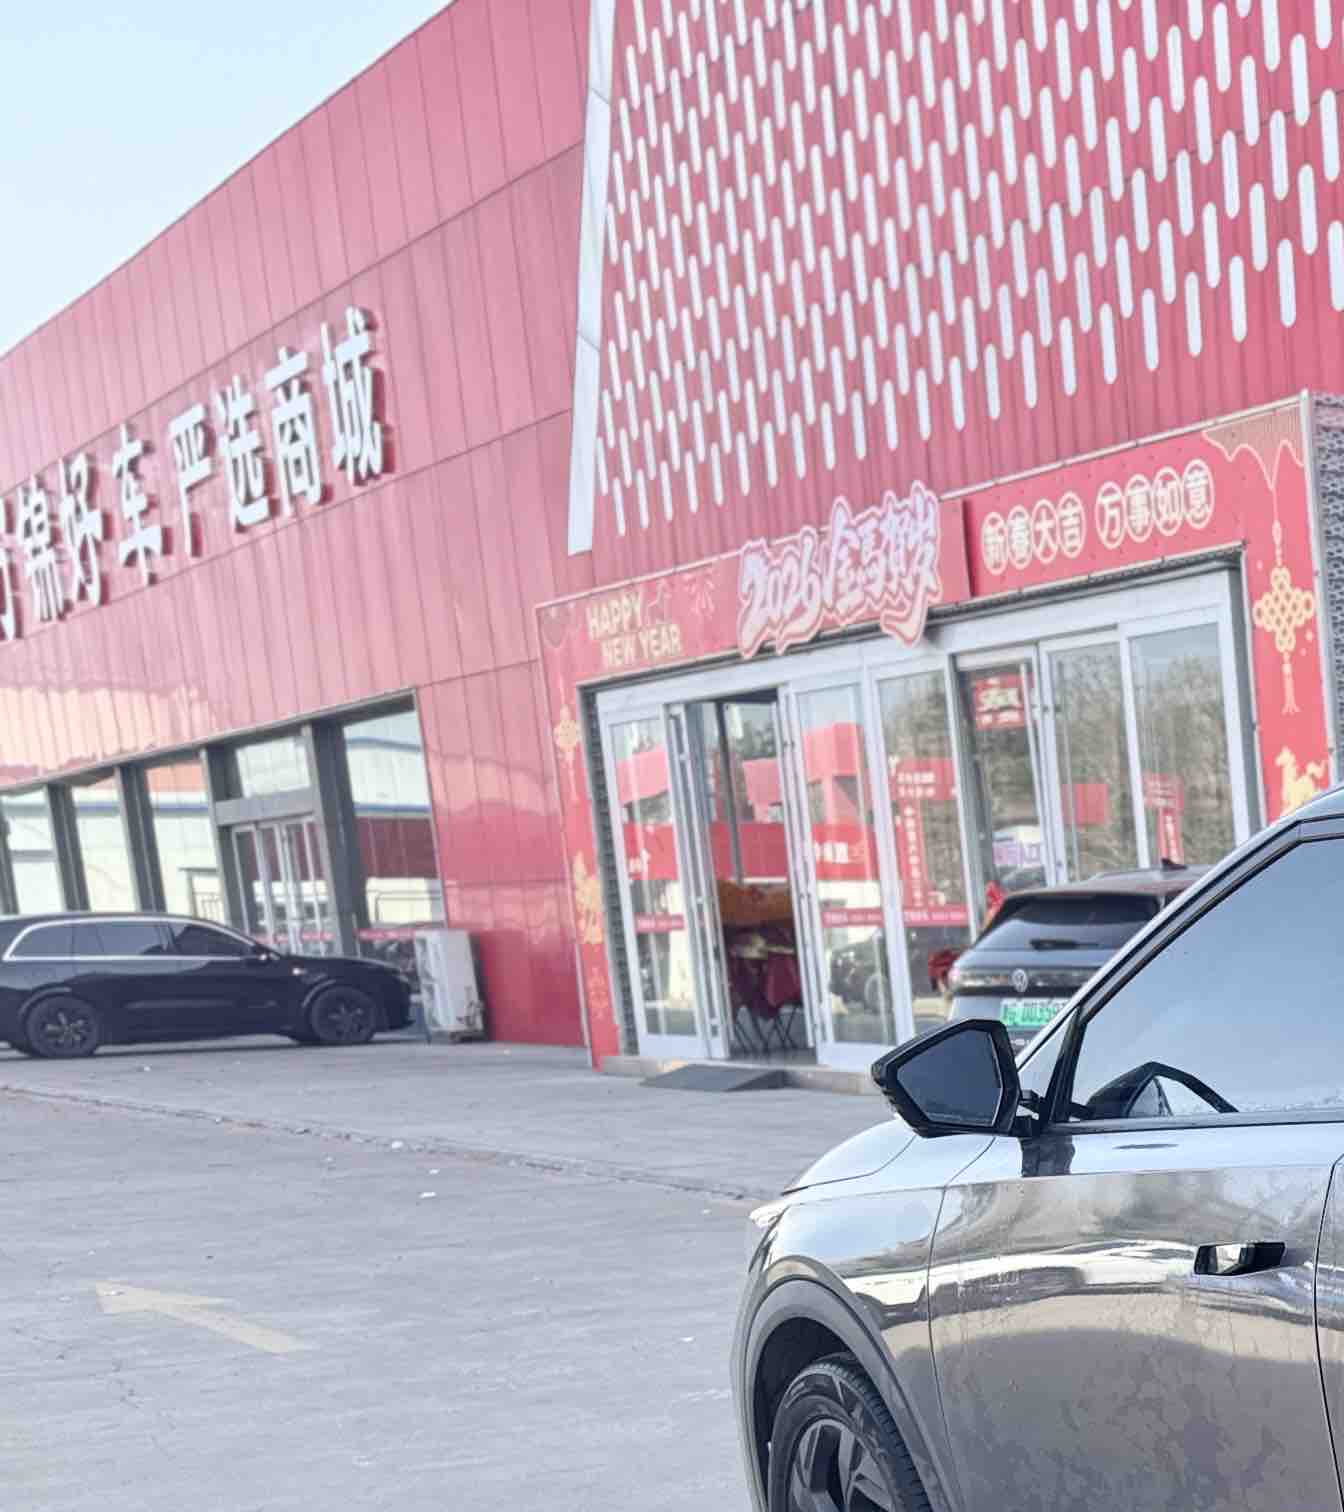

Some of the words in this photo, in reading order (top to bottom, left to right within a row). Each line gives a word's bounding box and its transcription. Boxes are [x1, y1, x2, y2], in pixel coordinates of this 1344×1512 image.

[0, 304, 384, 642] 锦好车严选商城
[981, 497, 1086, 573] 新春大吉
[1096, 460, 1215, 549] 万事如意
[586, 591, 643, 640] HAPPY
[601, 633, 637, 667] NEW
[637, 622, 682, 660] YEAR
